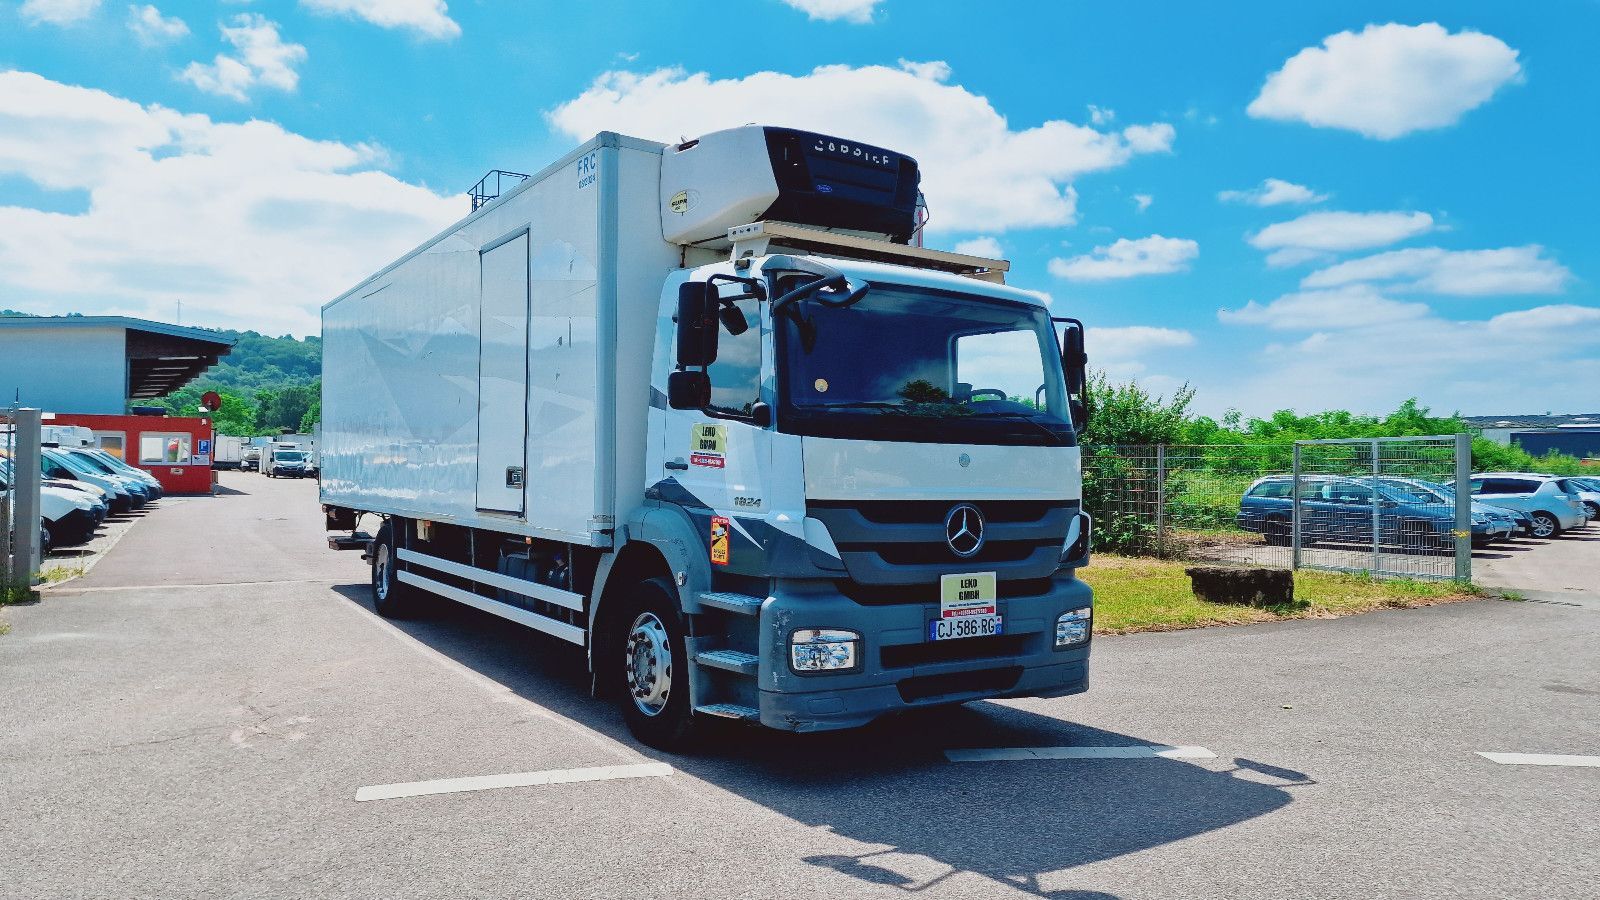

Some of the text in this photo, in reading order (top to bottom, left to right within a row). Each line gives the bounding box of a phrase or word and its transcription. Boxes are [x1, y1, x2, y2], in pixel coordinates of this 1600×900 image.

[577, 152, 596, 177] FRC
[702, 426, 716, 437] LEKO
[200, 441, 207, 449] P
[734, 496, 762, 507] 1824
[960, 578, 978, 589] LEKO
[958, 590, 980, 601] GMBH
[938, 618, 995, 639] CJ-586-RG
